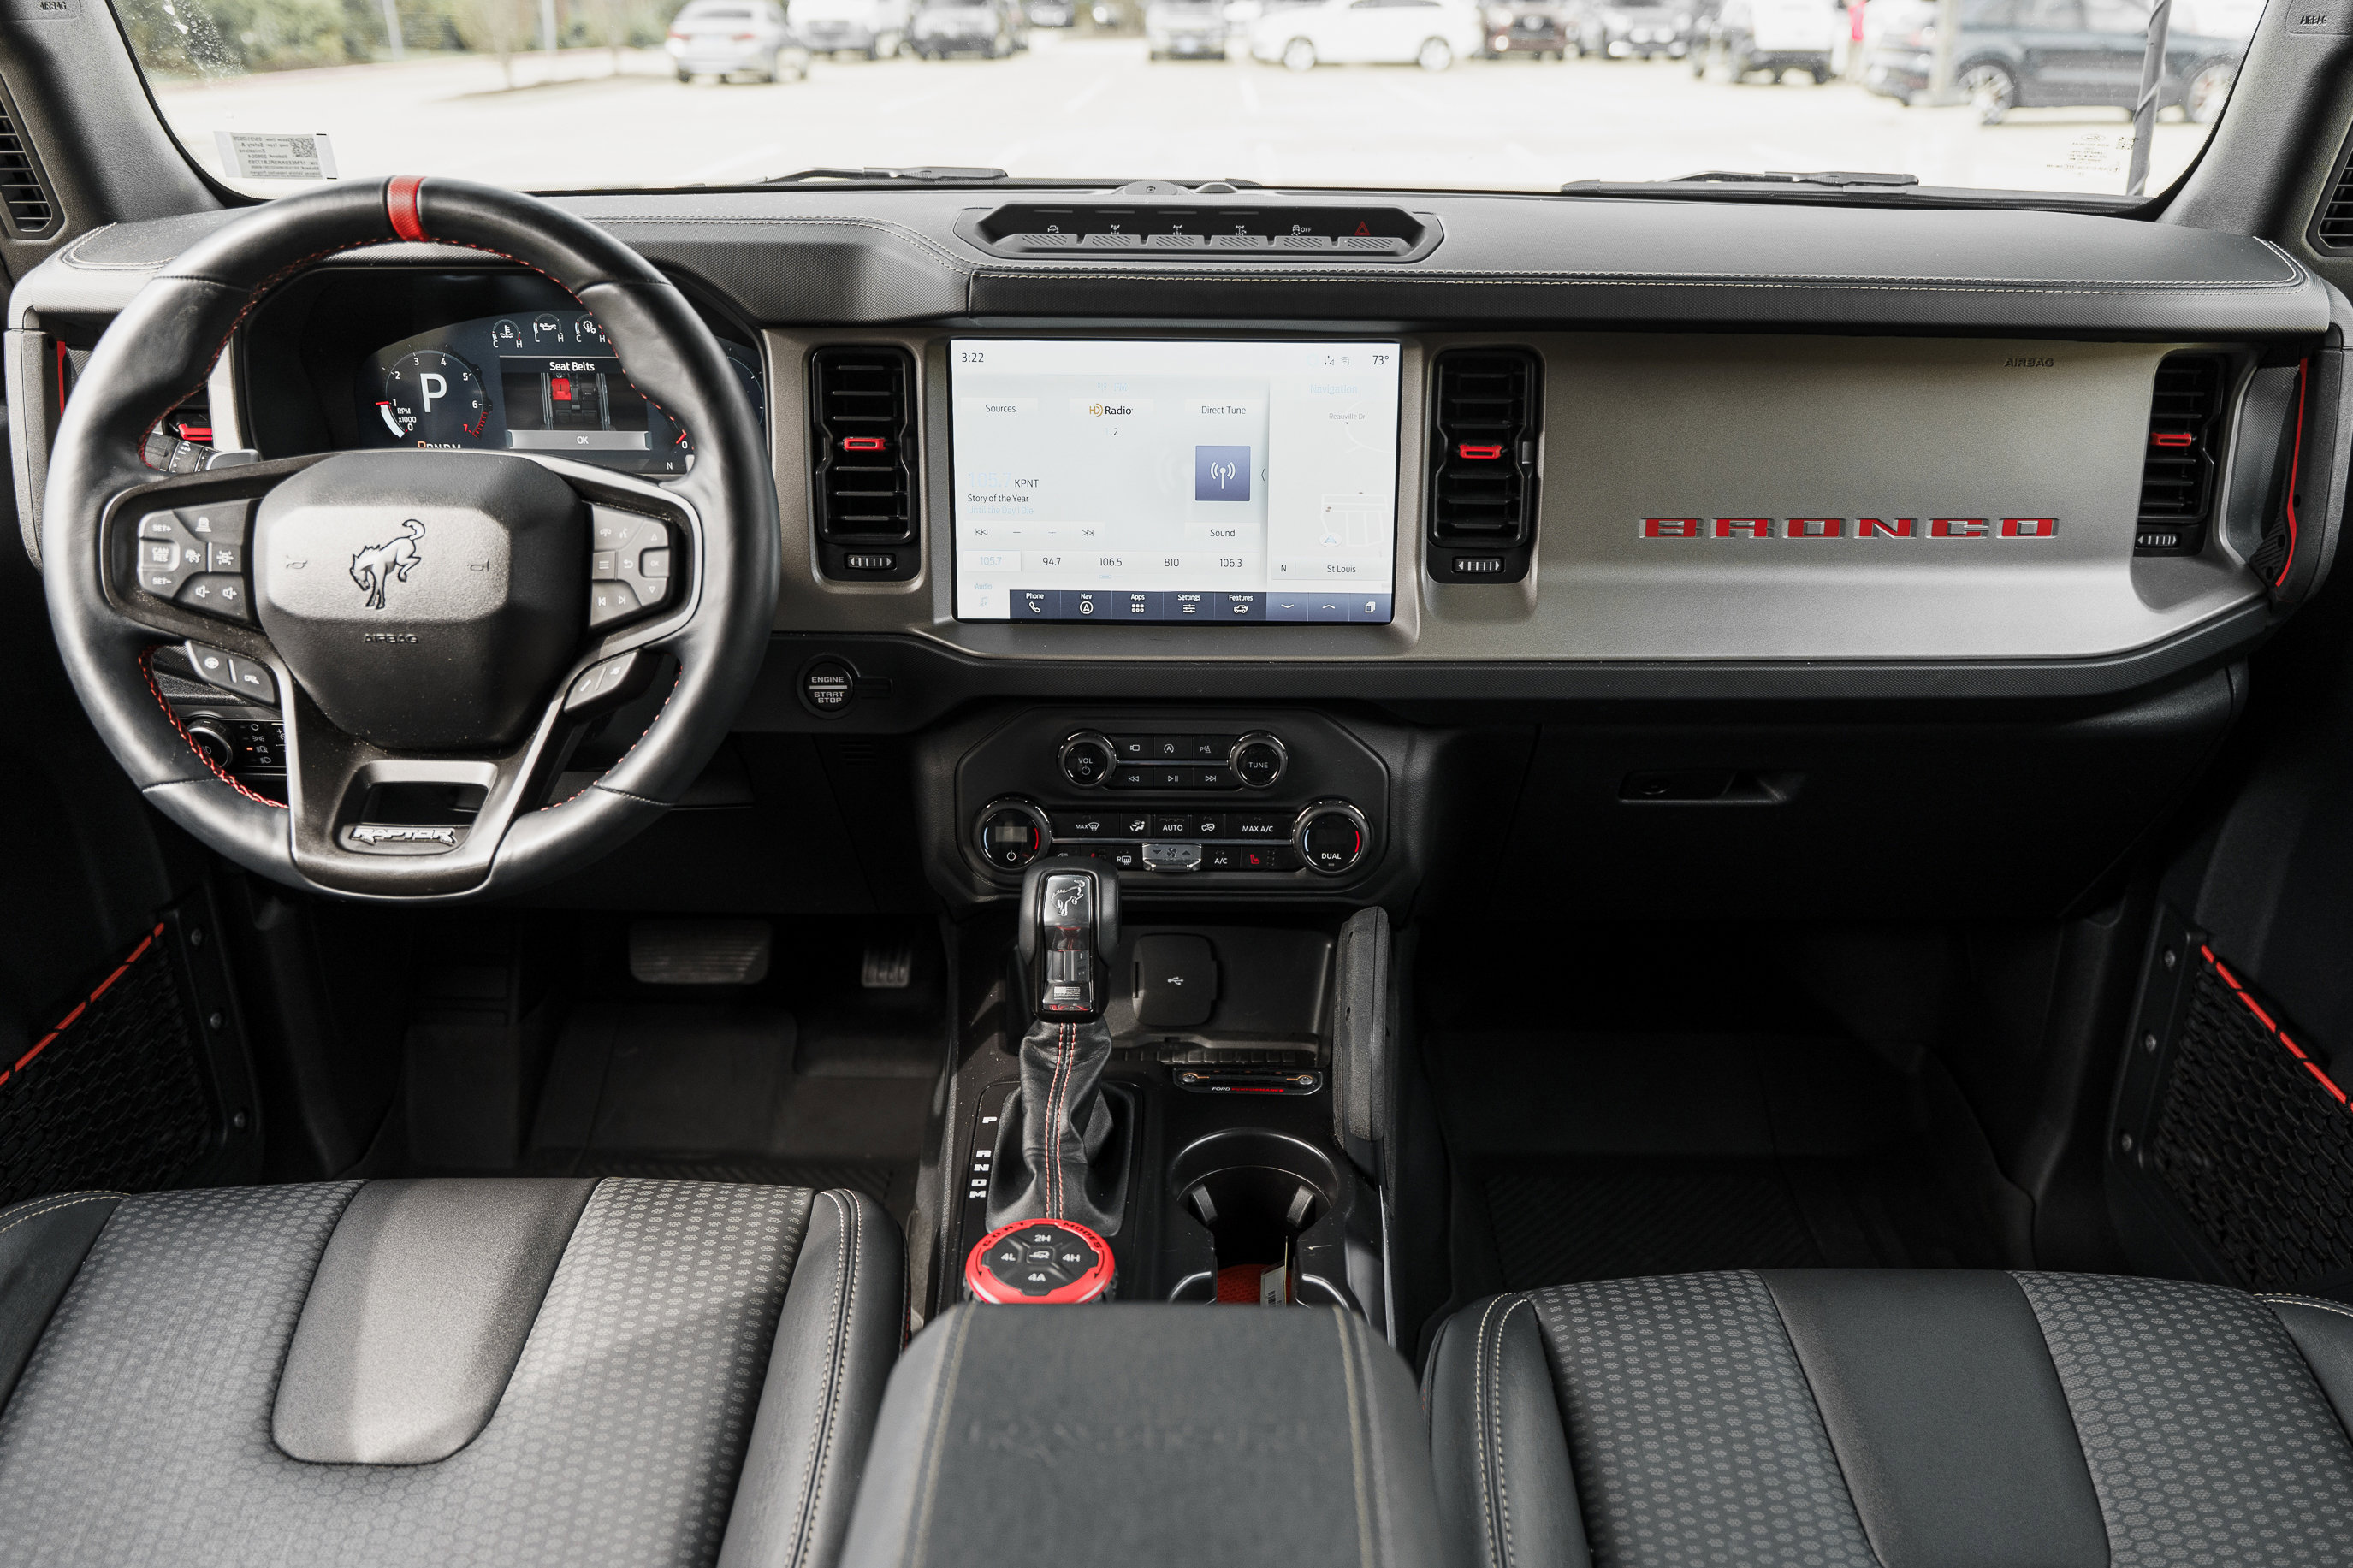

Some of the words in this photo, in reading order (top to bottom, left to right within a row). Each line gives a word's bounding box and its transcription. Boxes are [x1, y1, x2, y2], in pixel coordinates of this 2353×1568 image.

[40, 2, 67, 10] AIRBAG
[441, 358, 447, 366] 4
[962, 352, 984, 363] 3:22
[1372, 355, 1390, 365] 73°
[549, 361, 570, 371] Seat
[572, 361, 595, 371] Belts
[2004, 358, 2054, 368] AIRBAG
[394, 371, 400, 380] 2
[463, 372, 469, 381] 5
[420, 373, 447, 412] P
[1310, 384, 1358, 395] Navigation
[985, 404, 1016, 412] Sources
[1105, 405, 1132, 415] Radio
[1201, 405, 1224, 415] Direct
[1226, 405, 1247, 415] Tune
[577, 436, 589, 445] OK
[681, 441, 688, 449] 0
[1015, 479, 1039, 488] KPNT
[968, 494, 987, 503] Story
[988, 494, 998, 502] of
[1002, 506, 1016, 515] Day
[1210, 529, 1236, 537] Sound
[1639, 518, 2059, 539] BRONCO
[980, 557, 1002, 565] 105.7
[1042, 558, 1061, 566] 94.7
[1099, 558, 1123, 566] 106.5
[1164, 558, 1180, 567] 810
[1219, 559, 1242, 568] 106.3
[1327, 565, 1335, 573] St
[1337, 565, 1356, 573] Louis
[365, 633, 418, 643] AIRBAG
[350, 826, 456, 846] RAPTOR
[1064, 1222, 1103, 1249] MODES
[1000, 1252, 1016, 1262] 4L
[1062, 1253, 1081, 1262] 4H
[1028, 1273, 1046, 1282] 4A
